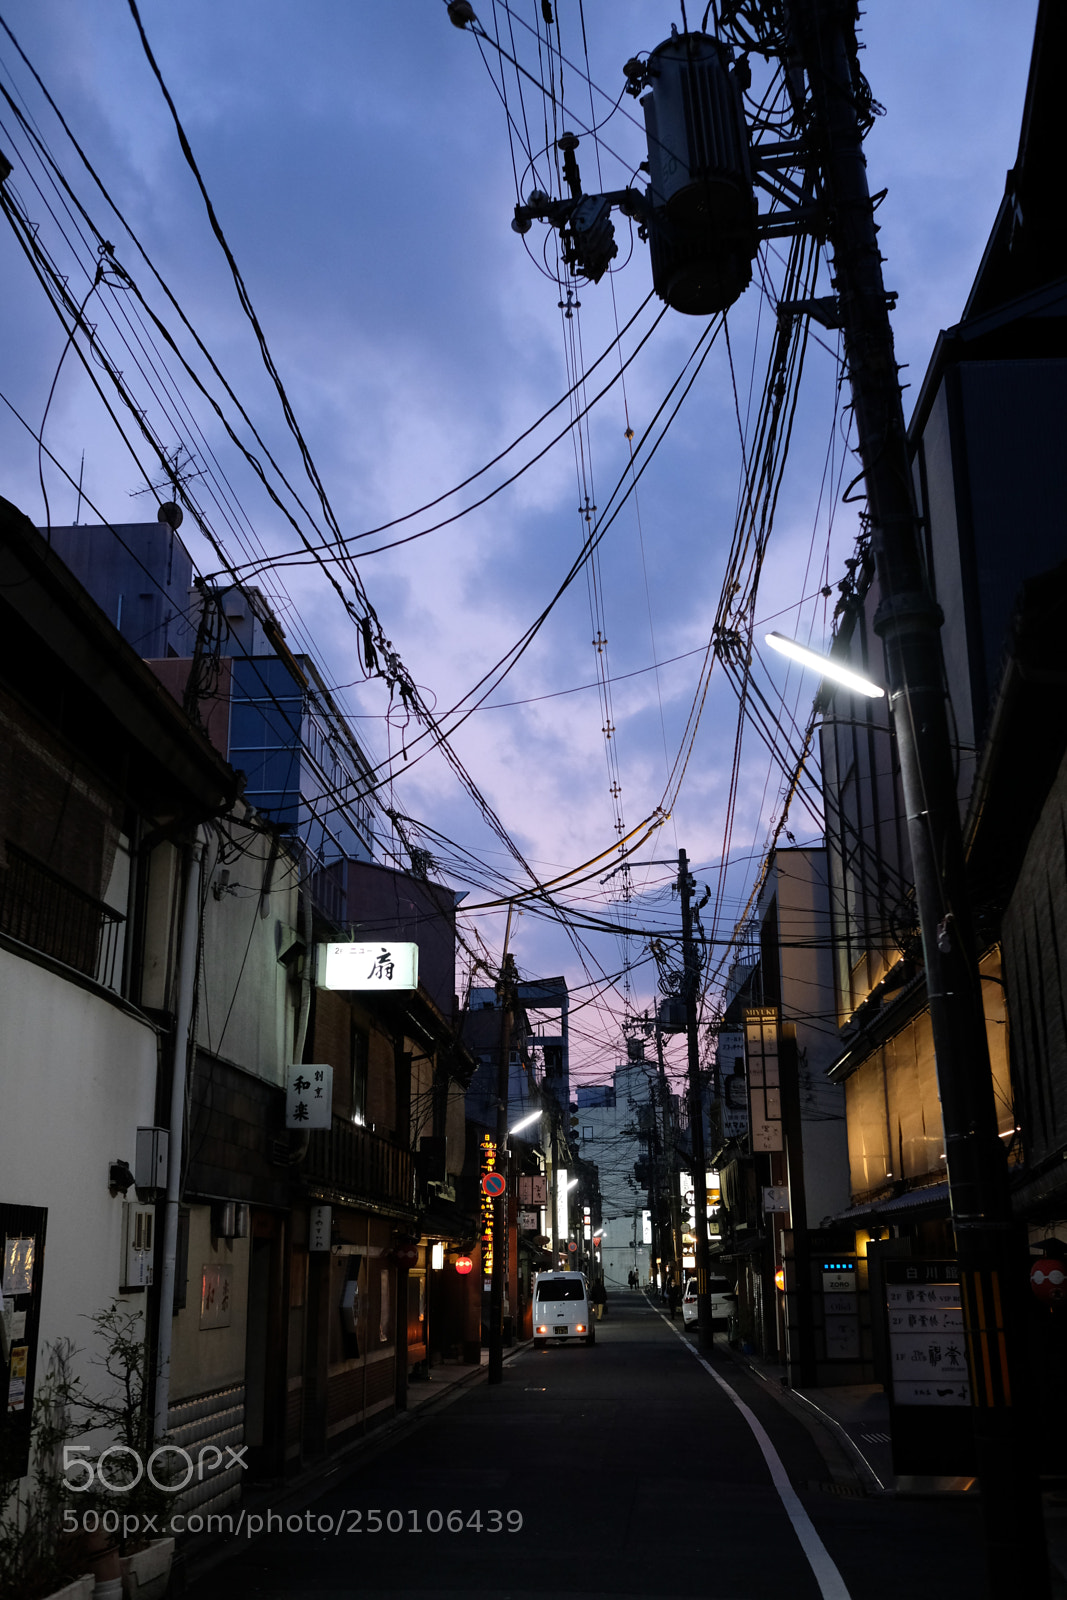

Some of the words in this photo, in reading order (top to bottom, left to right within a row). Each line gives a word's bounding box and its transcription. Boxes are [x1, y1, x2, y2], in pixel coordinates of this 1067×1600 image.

[367, 947, 395, 981] 扇
[293, 1075, 311, 1121] 和楽
[891, 1293, 902, 1301] 2F
[892, 1317, 903, 1325] 2F
